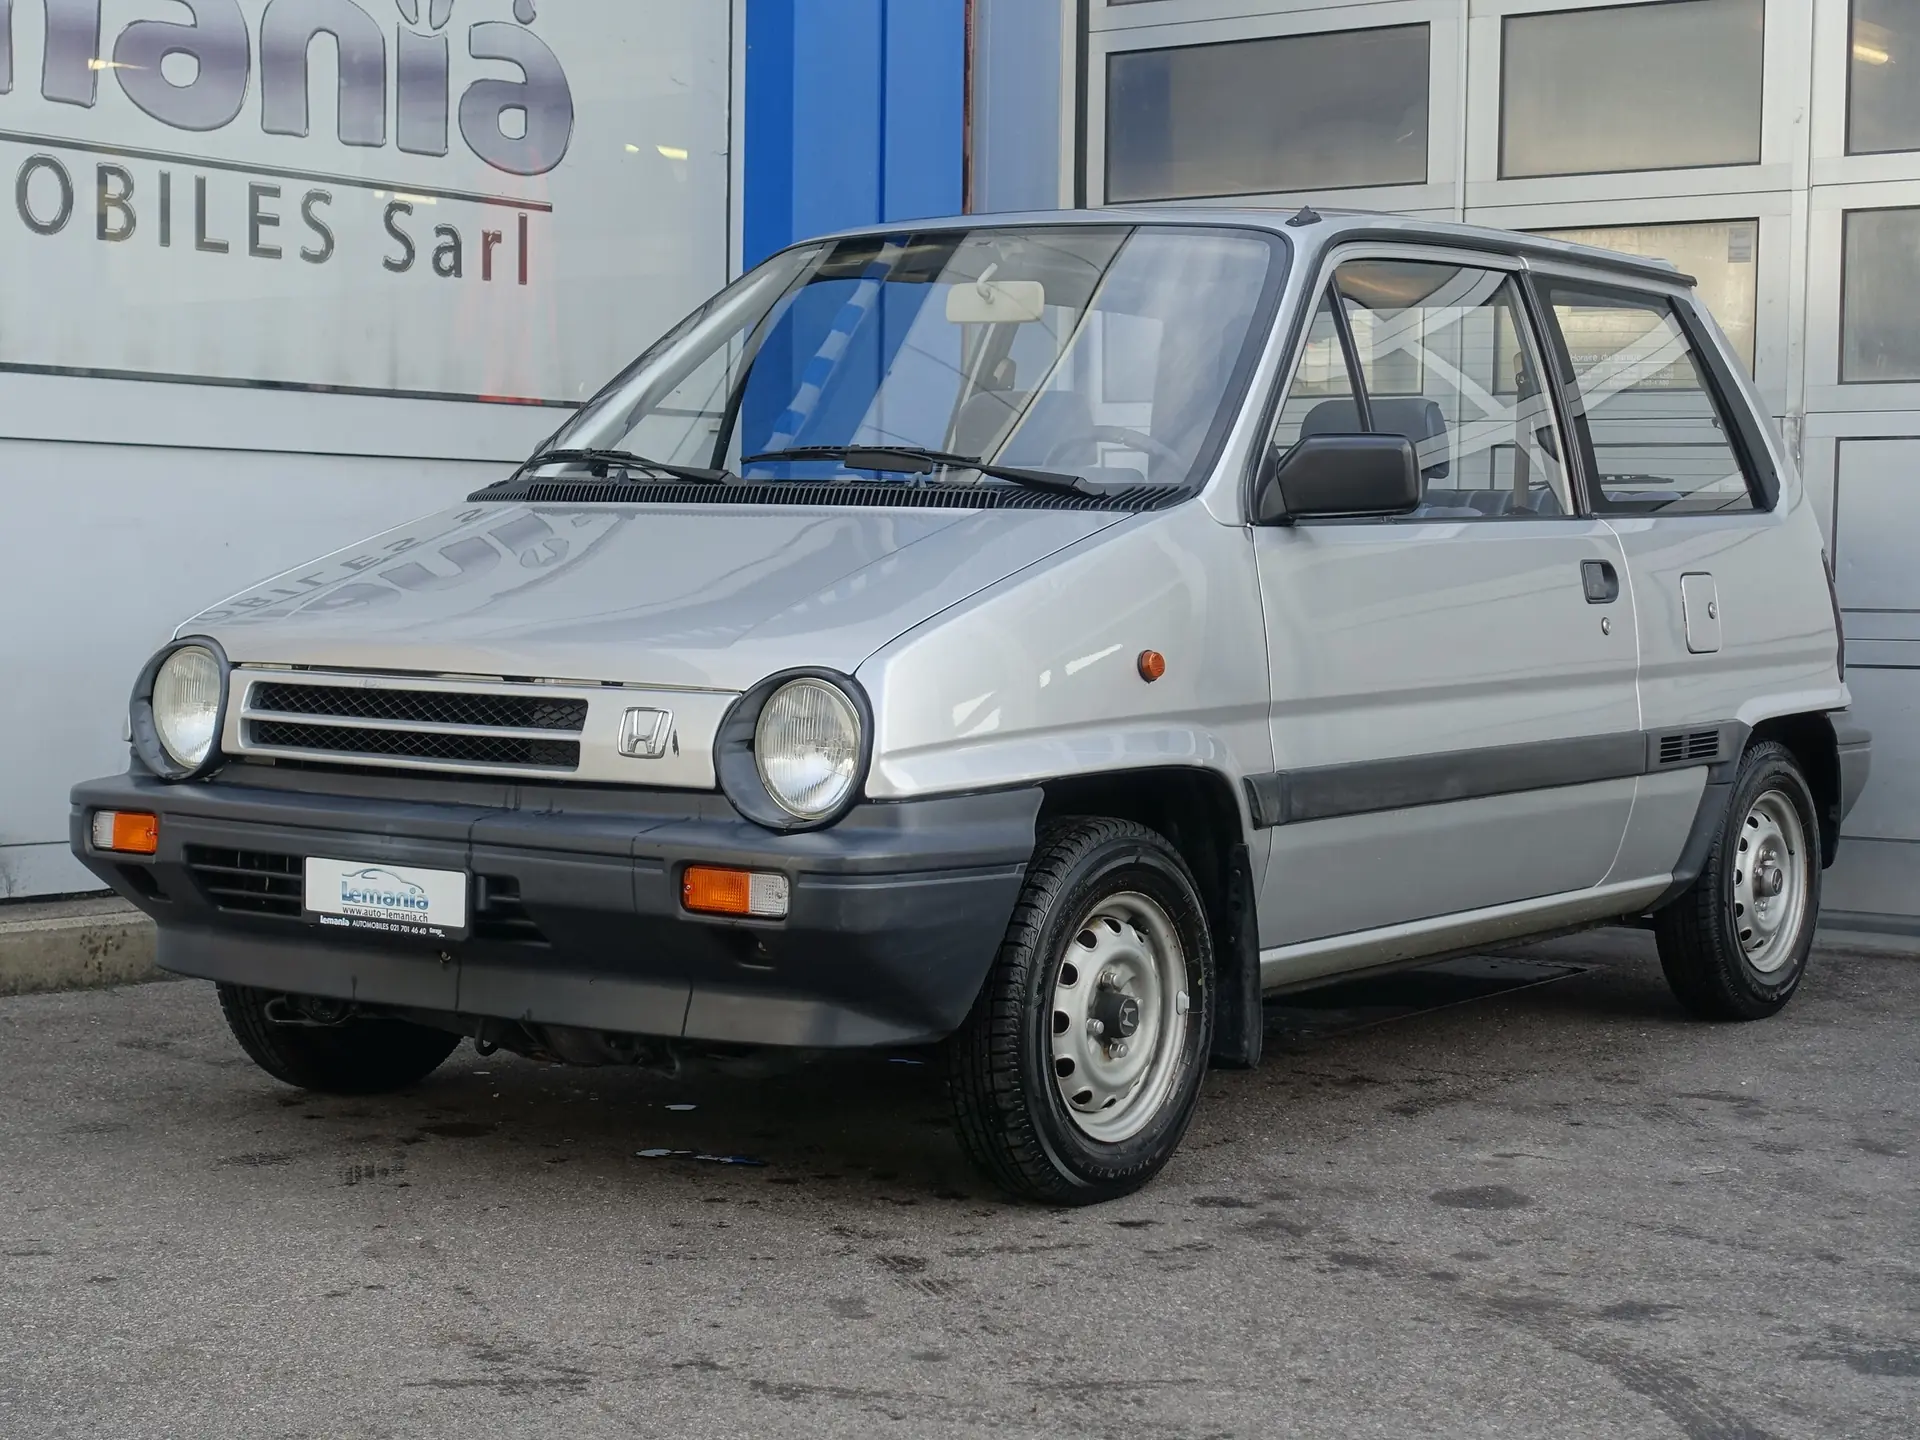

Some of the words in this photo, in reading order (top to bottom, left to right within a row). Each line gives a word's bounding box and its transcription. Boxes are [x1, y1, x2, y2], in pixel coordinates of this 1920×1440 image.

[16, 153, 335, 263] OBILES
[382, 200, 528, 285] Sarl
[341, 881, 429, 910] Lemania
[342, 907, 429, 923] www.auto-lemania.ch
[352, 919, 389, 931] AUTOMOBILES
[390, 924, 400, 932] 021
[400, 925, 410, 933] 701
[411, 926, 419, 934] 46
[419, 927, 427, 935] 40
